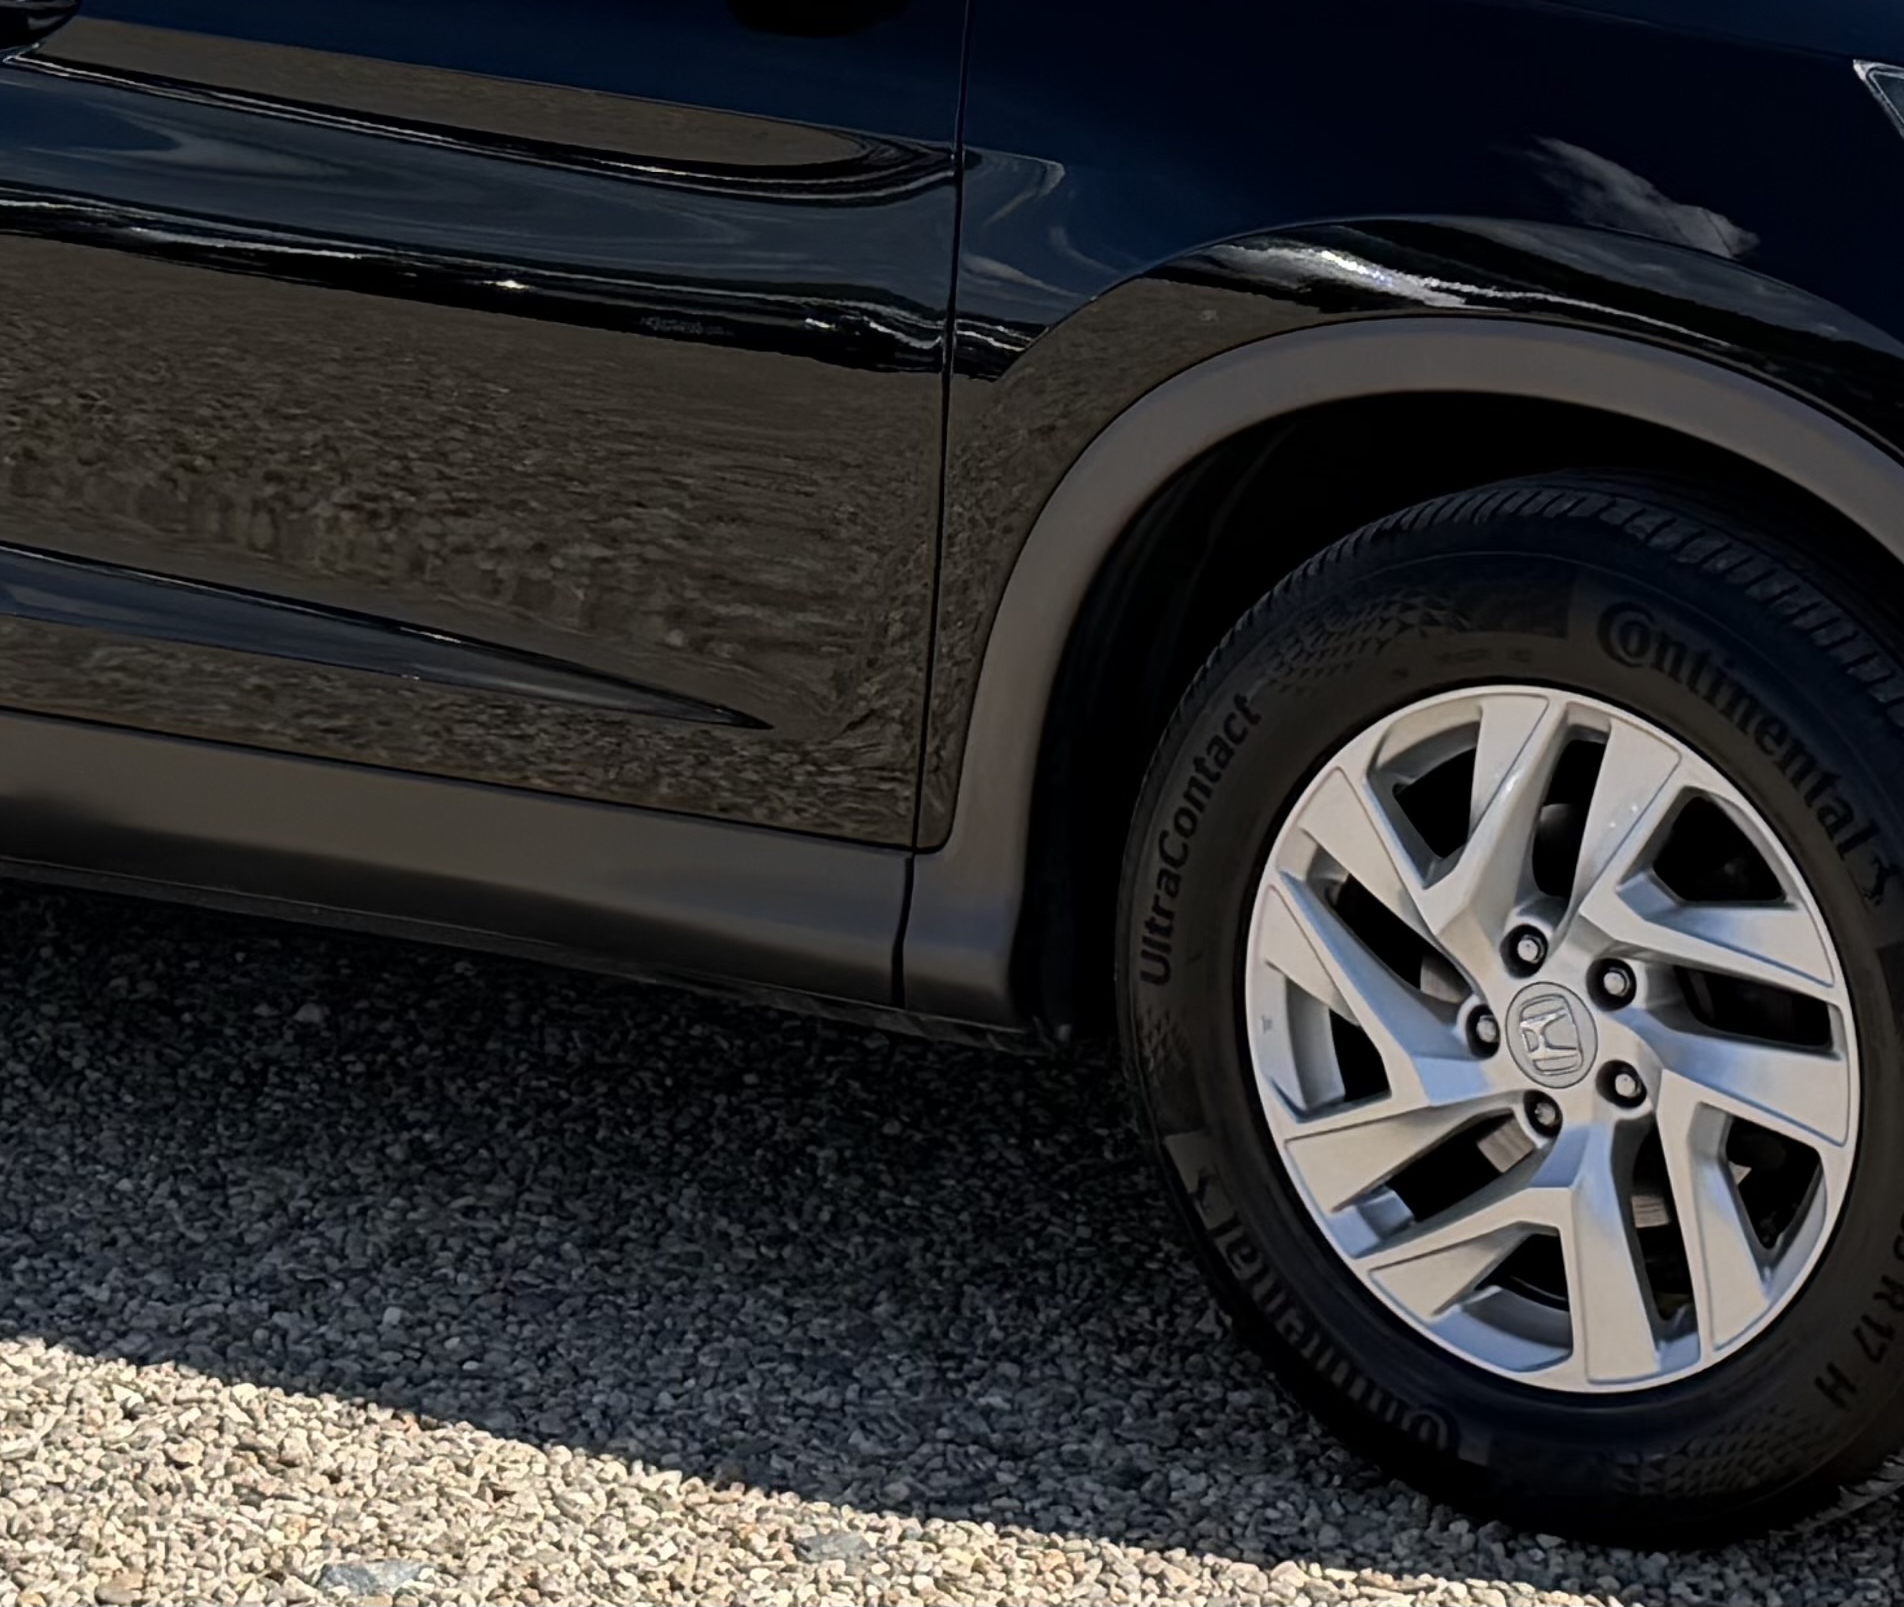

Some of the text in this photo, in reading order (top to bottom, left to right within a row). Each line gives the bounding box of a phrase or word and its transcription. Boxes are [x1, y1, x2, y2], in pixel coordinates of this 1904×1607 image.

[1139, 693, 1262, 987] UltraContact
[1597, 601, 1880, 860] Continental
[1814, 1361, 1857, 1411] H
